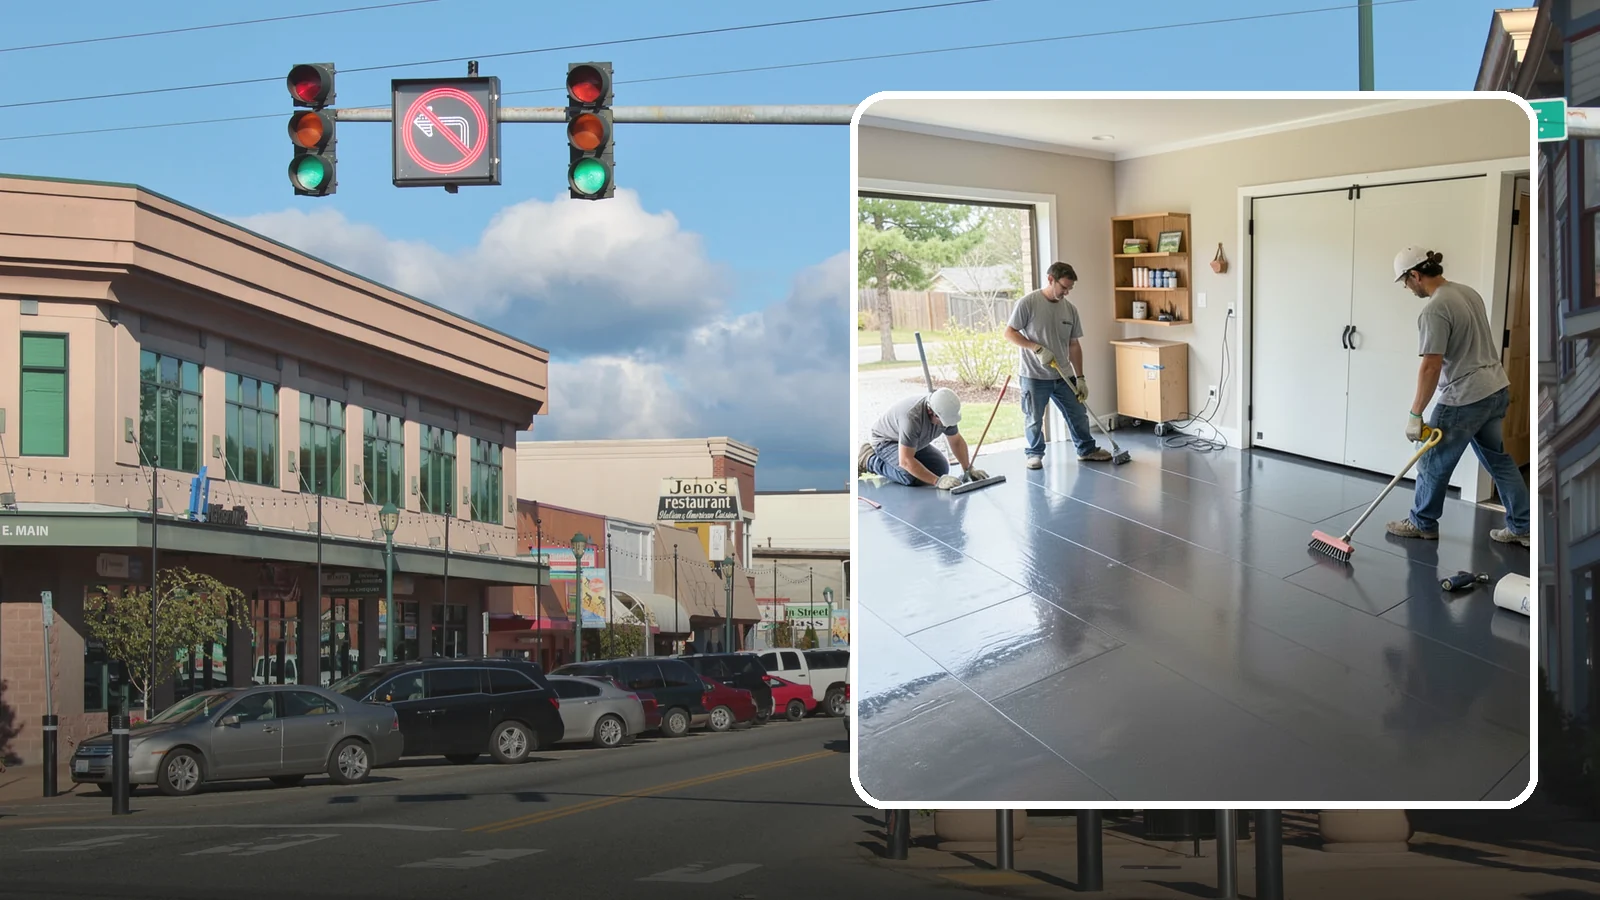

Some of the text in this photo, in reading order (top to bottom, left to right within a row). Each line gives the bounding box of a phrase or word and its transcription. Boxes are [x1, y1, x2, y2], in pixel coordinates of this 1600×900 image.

[670, 480, 727, 494] Jeno's
[665, 496, 731, 509] restaurant
[659, 510, 681, 519] Italian
[686, 510, 714, 519] American
[715, 509, 737, 519] Cuisine
[2, 525, 49, 536] E. MAIN
[786, 607, 828, 617] in Street
